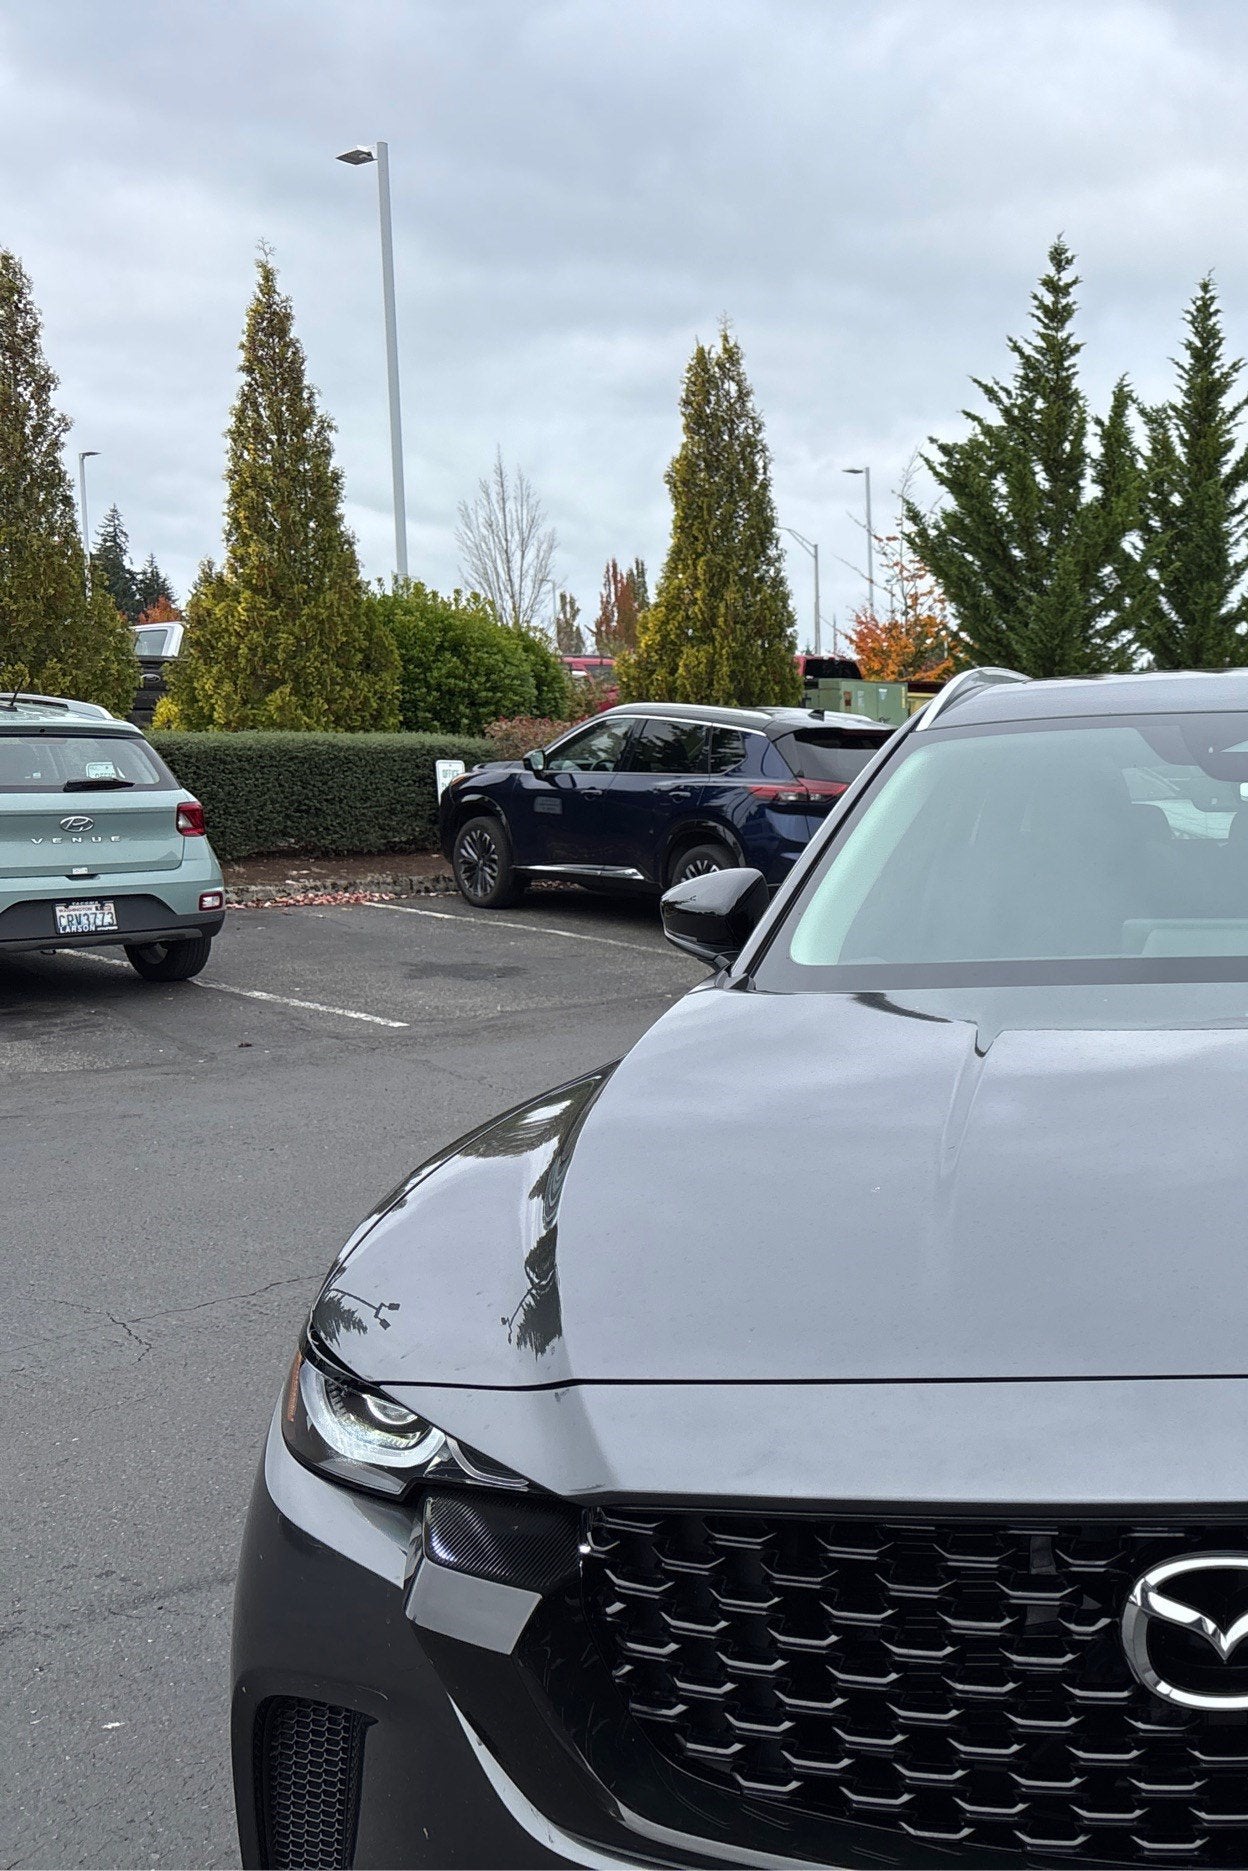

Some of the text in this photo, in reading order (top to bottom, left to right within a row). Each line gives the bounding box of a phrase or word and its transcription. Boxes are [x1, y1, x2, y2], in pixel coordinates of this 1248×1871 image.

[31, 835, 121, 844] VENUE
[59, 912, 114, 927] CRV3773
[59, 925, 96, 934] LARSON
